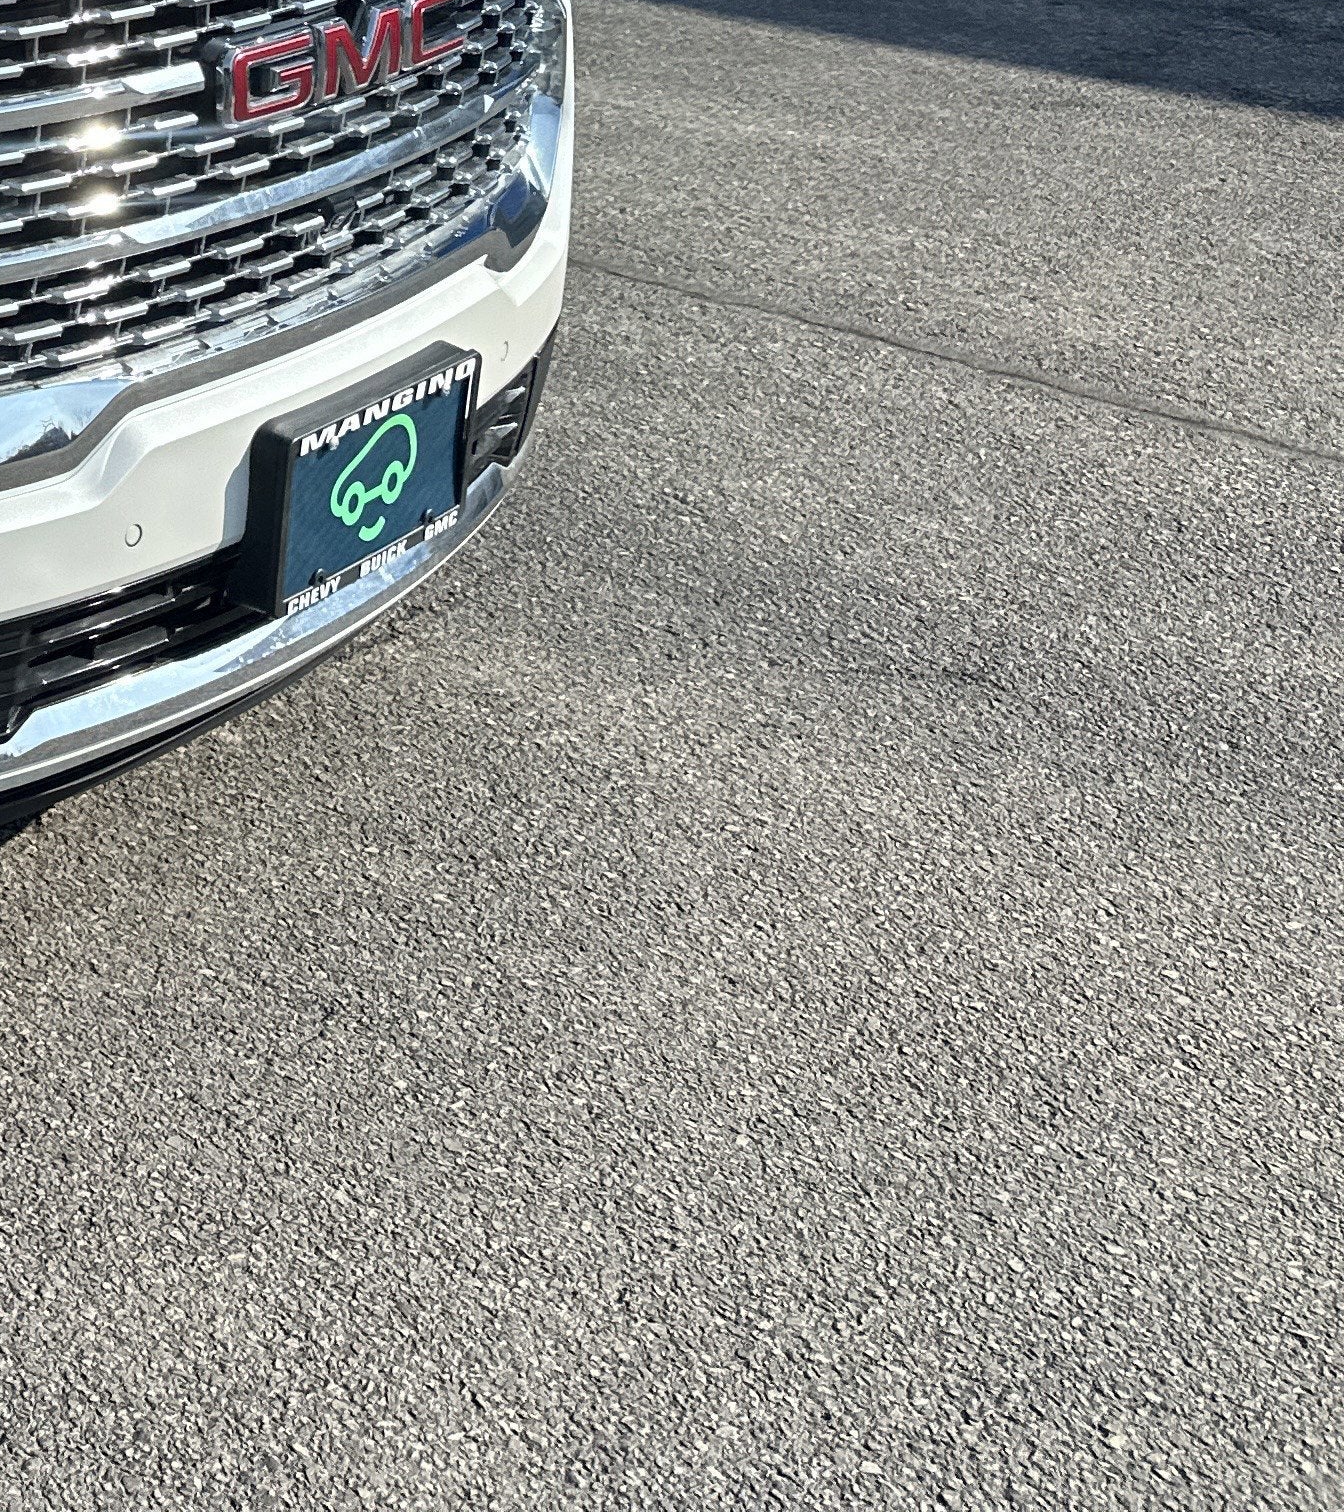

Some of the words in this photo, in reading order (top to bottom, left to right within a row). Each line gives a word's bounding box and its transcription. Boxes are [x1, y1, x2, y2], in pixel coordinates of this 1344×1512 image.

[299, 358, 476, 457] MANGINO
[286, 575, 342, 616] CHEVY
[360, 539, 408, 578] BUICK
[424, 510, 459, 542] GMC
